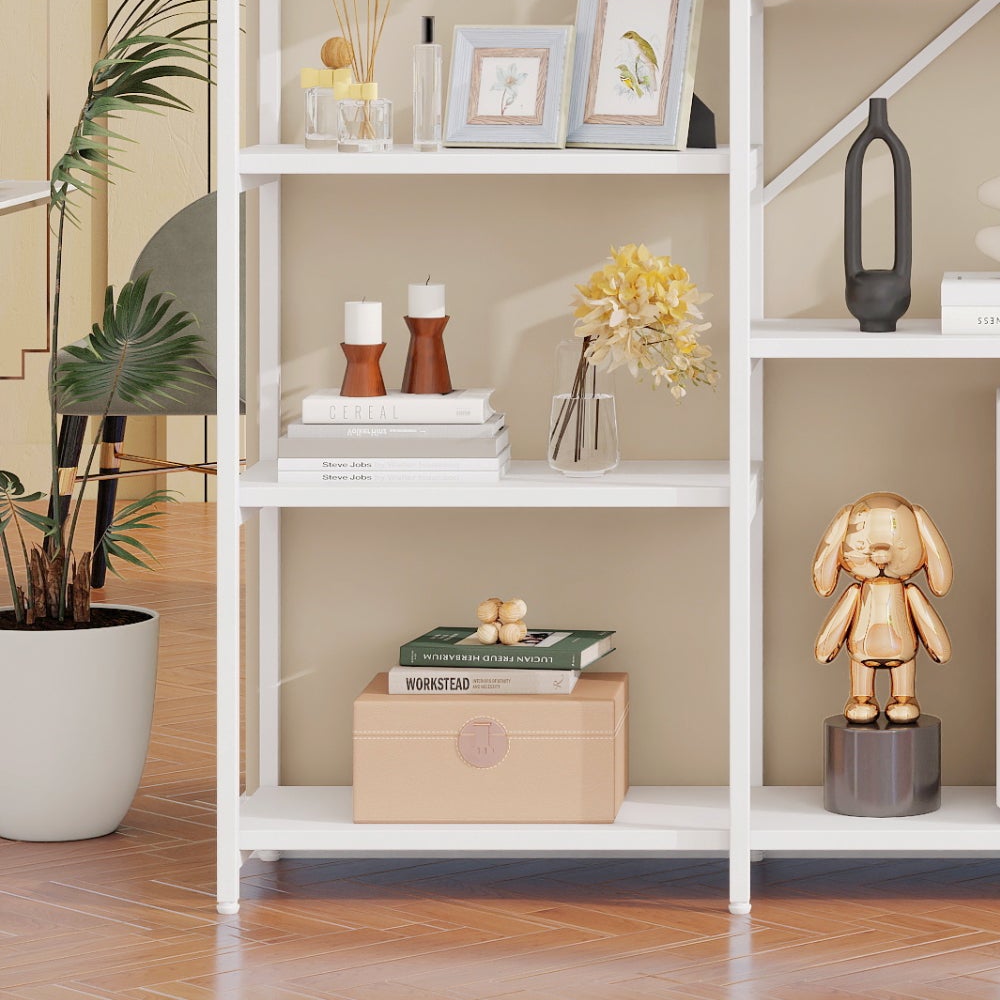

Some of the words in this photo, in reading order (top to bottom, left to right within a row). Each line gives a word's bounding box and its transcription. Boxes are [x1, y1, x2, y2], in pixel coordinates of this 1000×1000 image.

[329, 405, 400, 420] CEREAL
[423, 653, 480, 662] HERBARIUM
[482, 655, 514, 663] FREUD
[516, 656, 554, 664] LUCIAN
[405, 677, 470, 691] WORKSTEAD
